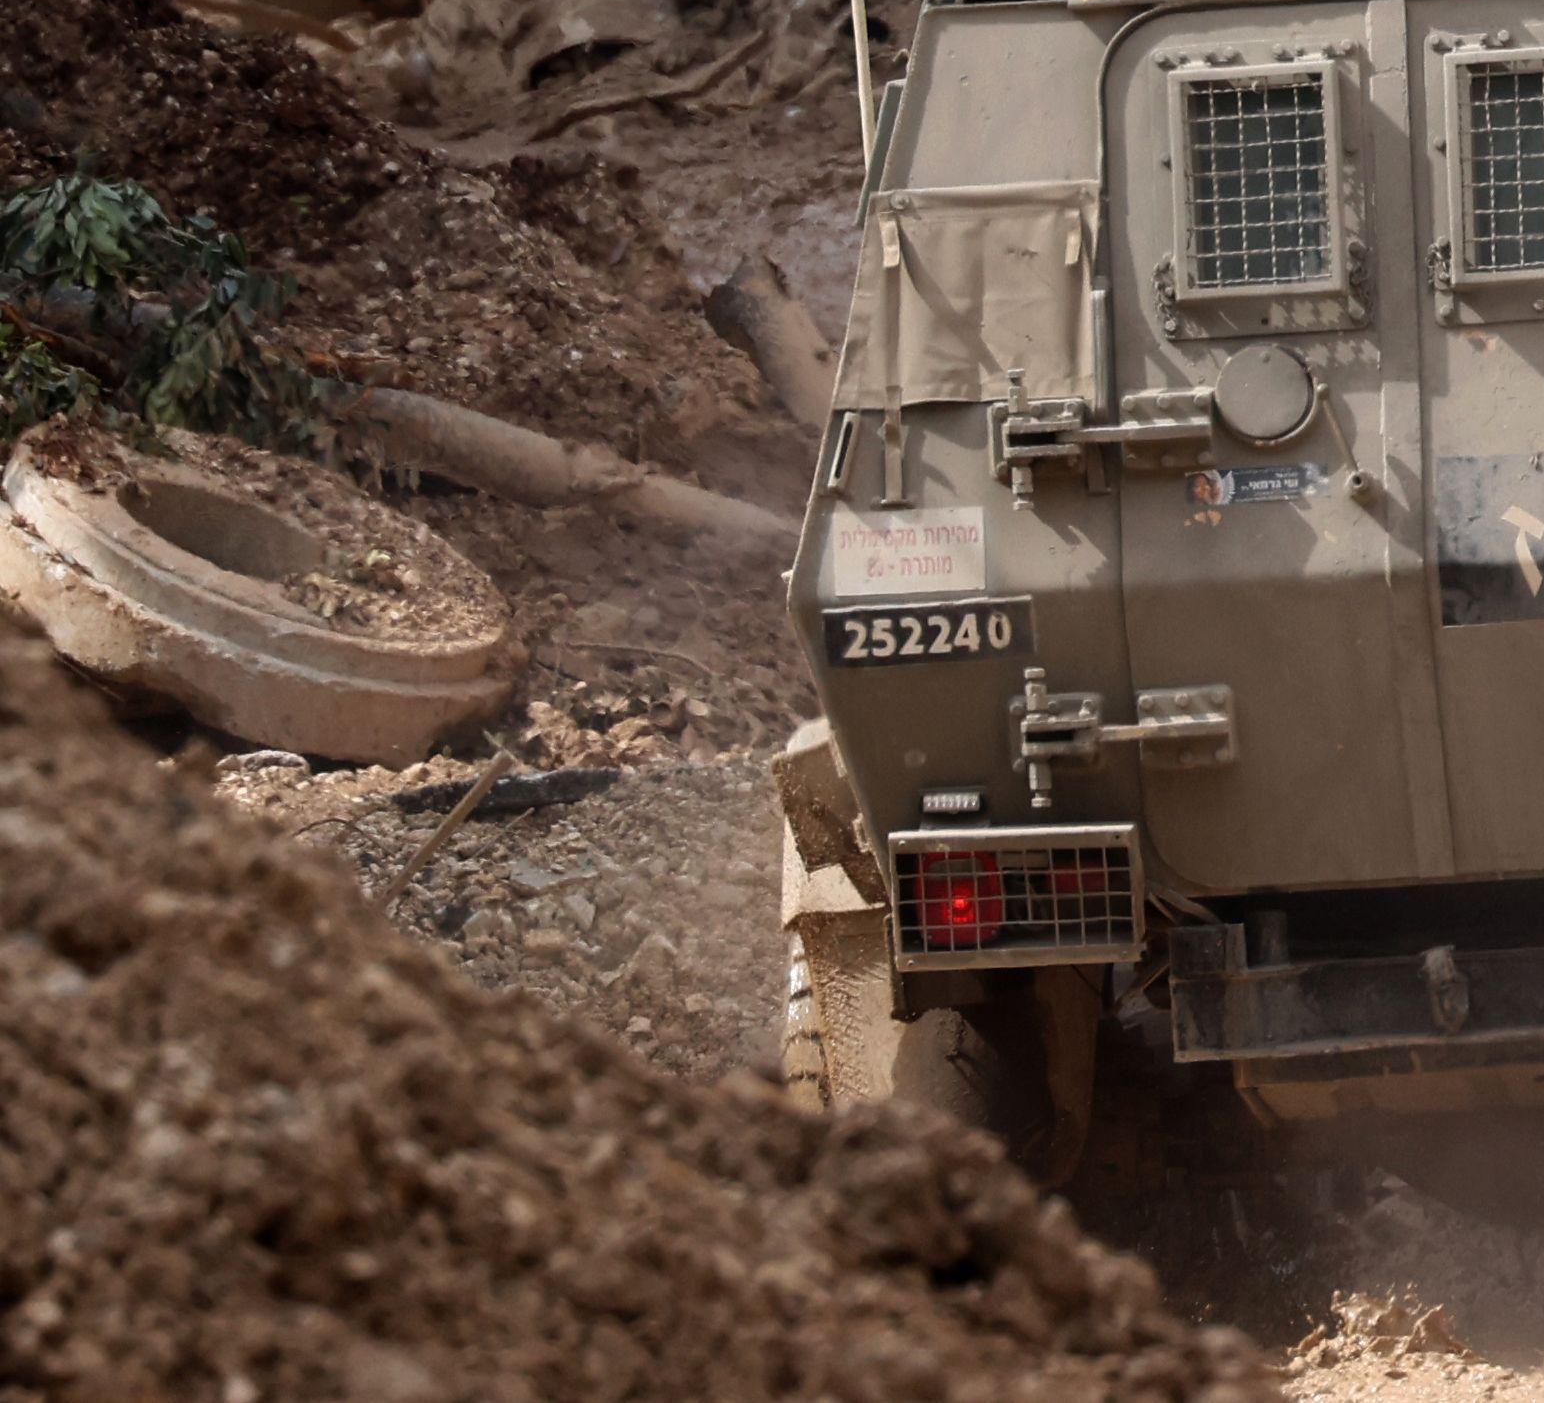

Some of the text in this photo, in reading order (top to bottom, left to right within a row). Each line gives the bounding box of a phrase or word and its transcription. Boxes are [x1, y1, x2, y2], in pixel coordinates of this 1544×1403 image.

[923, 524, 979, 546] מהירות
[901, 555, 954, 576] מותרה
[843, 612, 1012, 659] 252240
